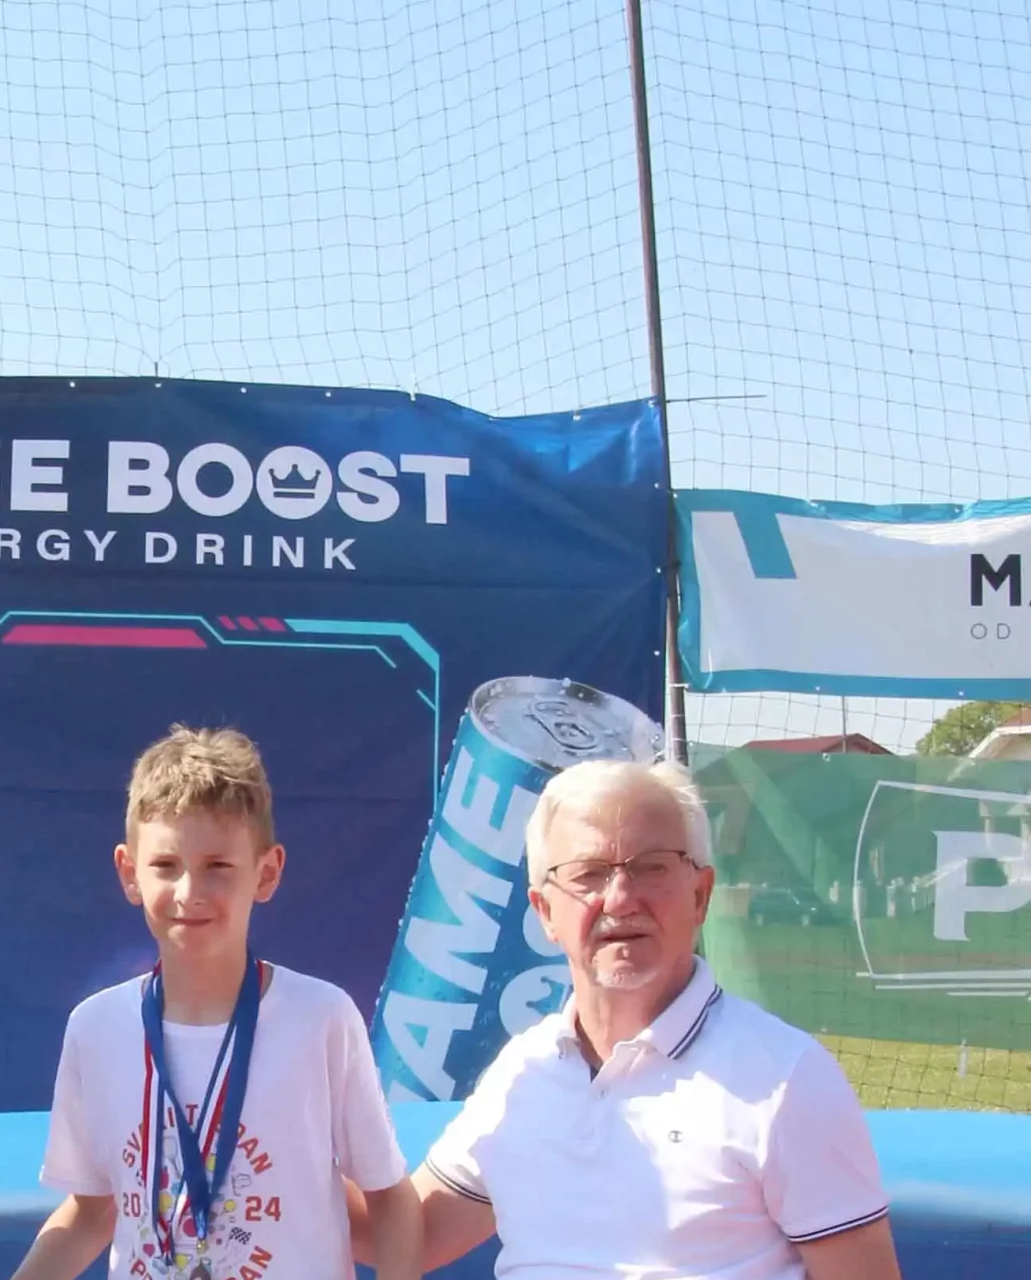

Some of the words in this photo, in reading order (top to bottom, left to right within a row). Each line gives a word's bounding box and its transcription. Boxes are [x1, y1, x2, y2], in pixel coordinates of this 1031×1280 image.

[107, 440, 470, 524] BOOST
[145, 531, 357, 570] DRINK
[971, 554, 1031, 606] M
[245, 1196, 281, 1221] 24
